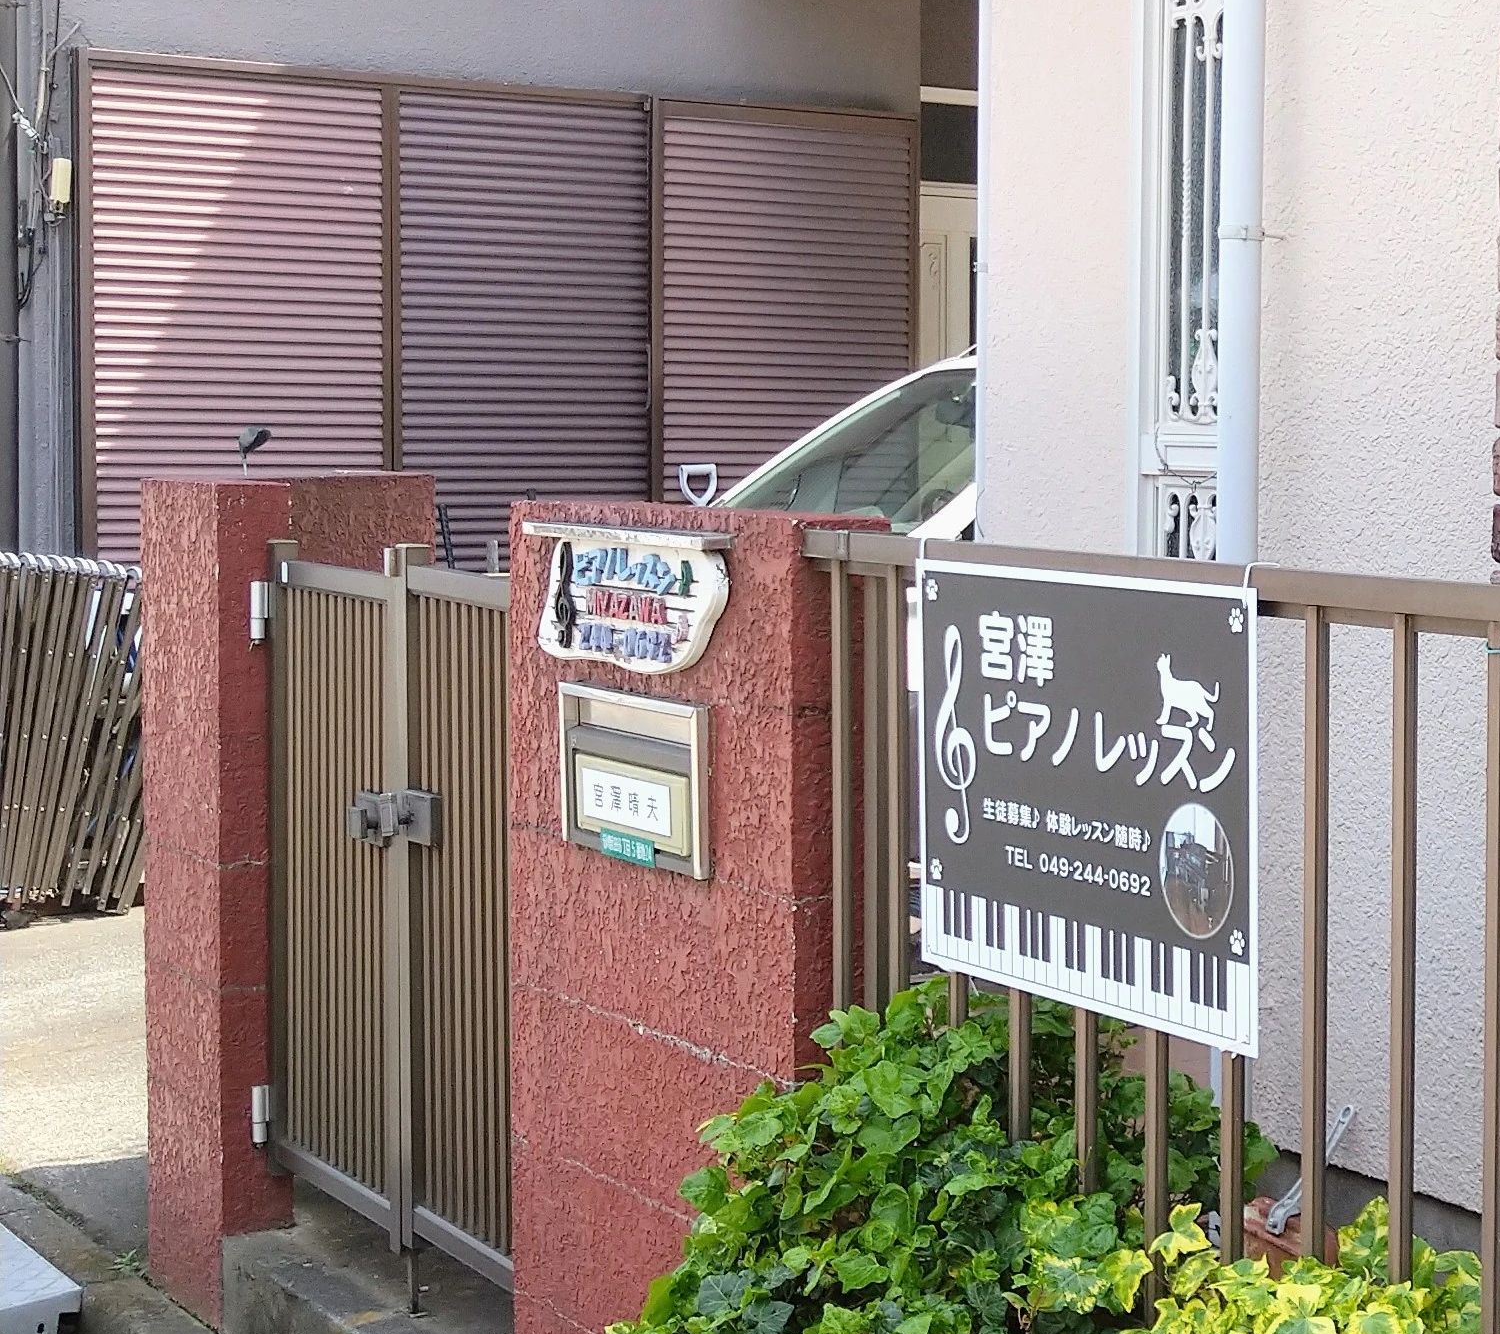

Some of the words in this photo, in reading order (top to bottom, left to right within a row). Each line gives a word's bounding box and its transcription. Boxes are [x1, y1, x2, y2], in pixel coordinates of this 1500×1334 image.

[586, 587, 667, 625] MIYAZAWA
[979, 610, 1054, 687] 宮澤
[1004, 845, 1033, 870] TEL
[1039, 853, 1151, 897] 049-244-0692
